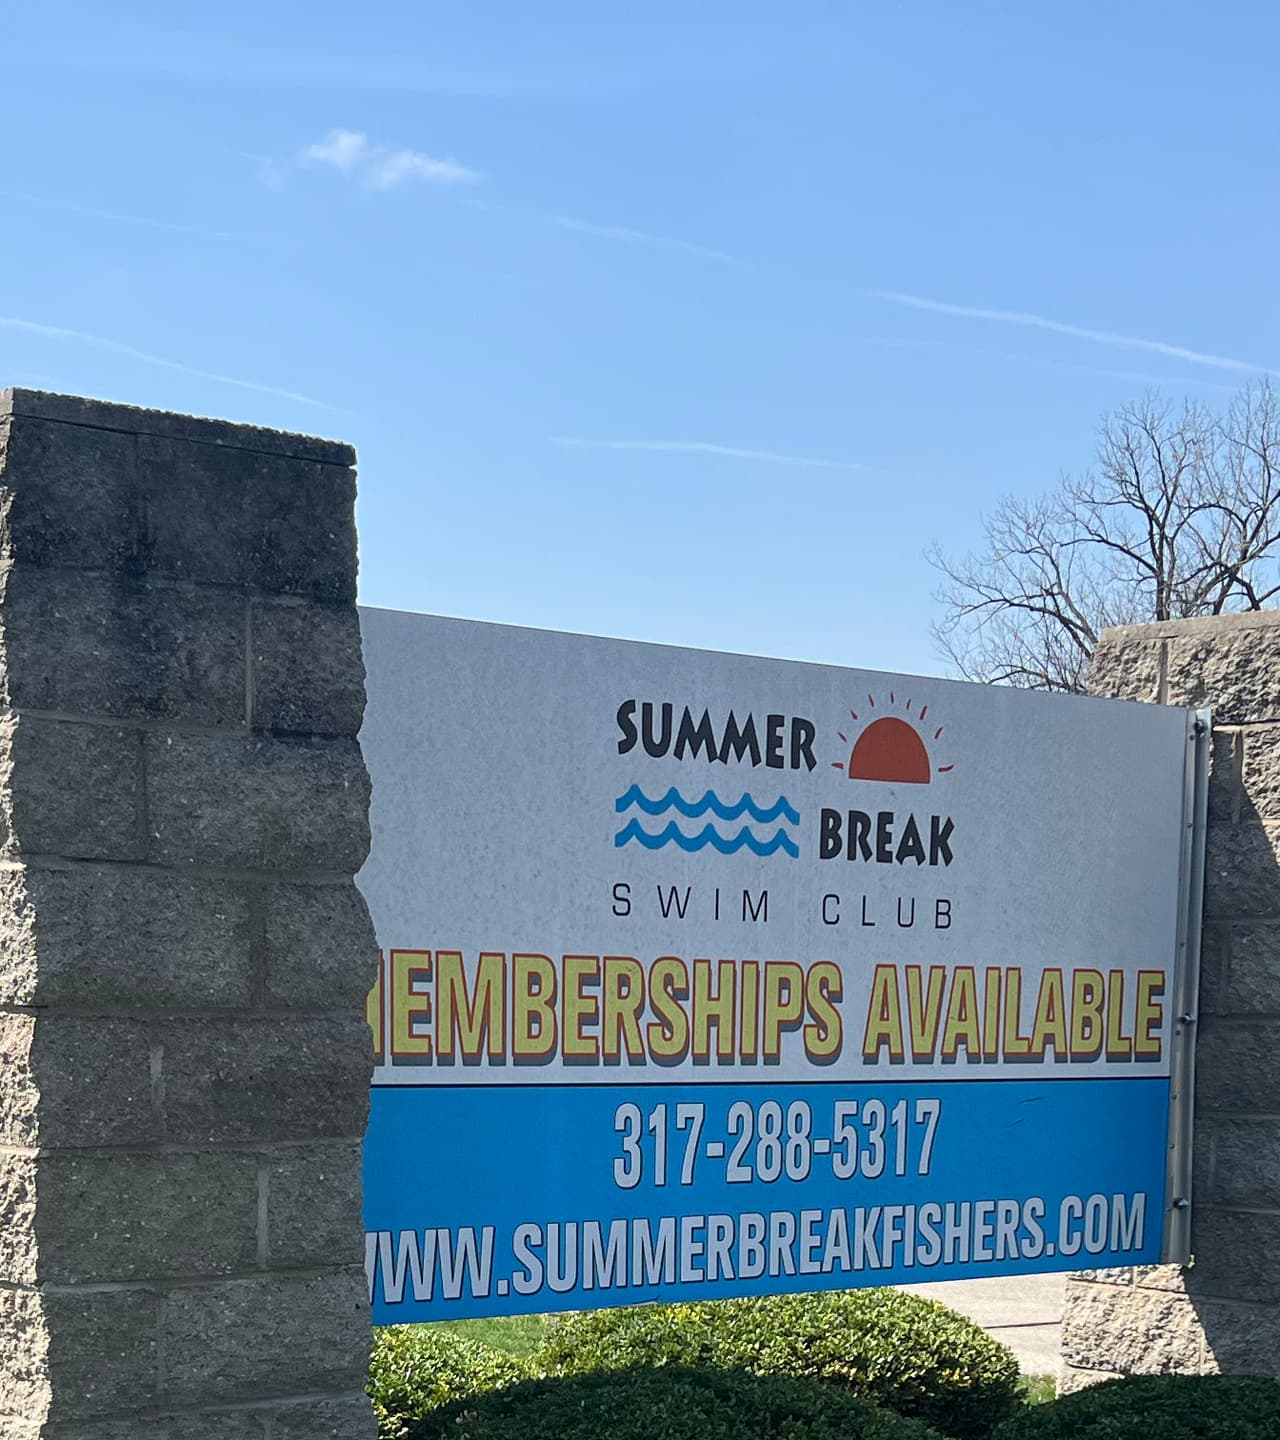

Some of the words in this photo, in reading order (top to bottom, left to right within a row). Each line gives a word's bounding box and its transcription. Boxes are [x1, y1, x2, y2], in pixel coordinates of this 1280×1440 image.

[616, 700, 817, 772] SUMMER
[820, 808, 955, 867] BREAK
[612, 884, 769, 922] SWIM
[822, 895, 952, 929] CLUB
[365, 949, 843, 1066] EMBERSHIPS
[863, 964, 1165, 1064] AVAILABLE
[613, 1099, 941, 1189] 317-288-5317
[365, 1193, 1146, 1304] WW.SUMMERBREAKFISHERS.COM
